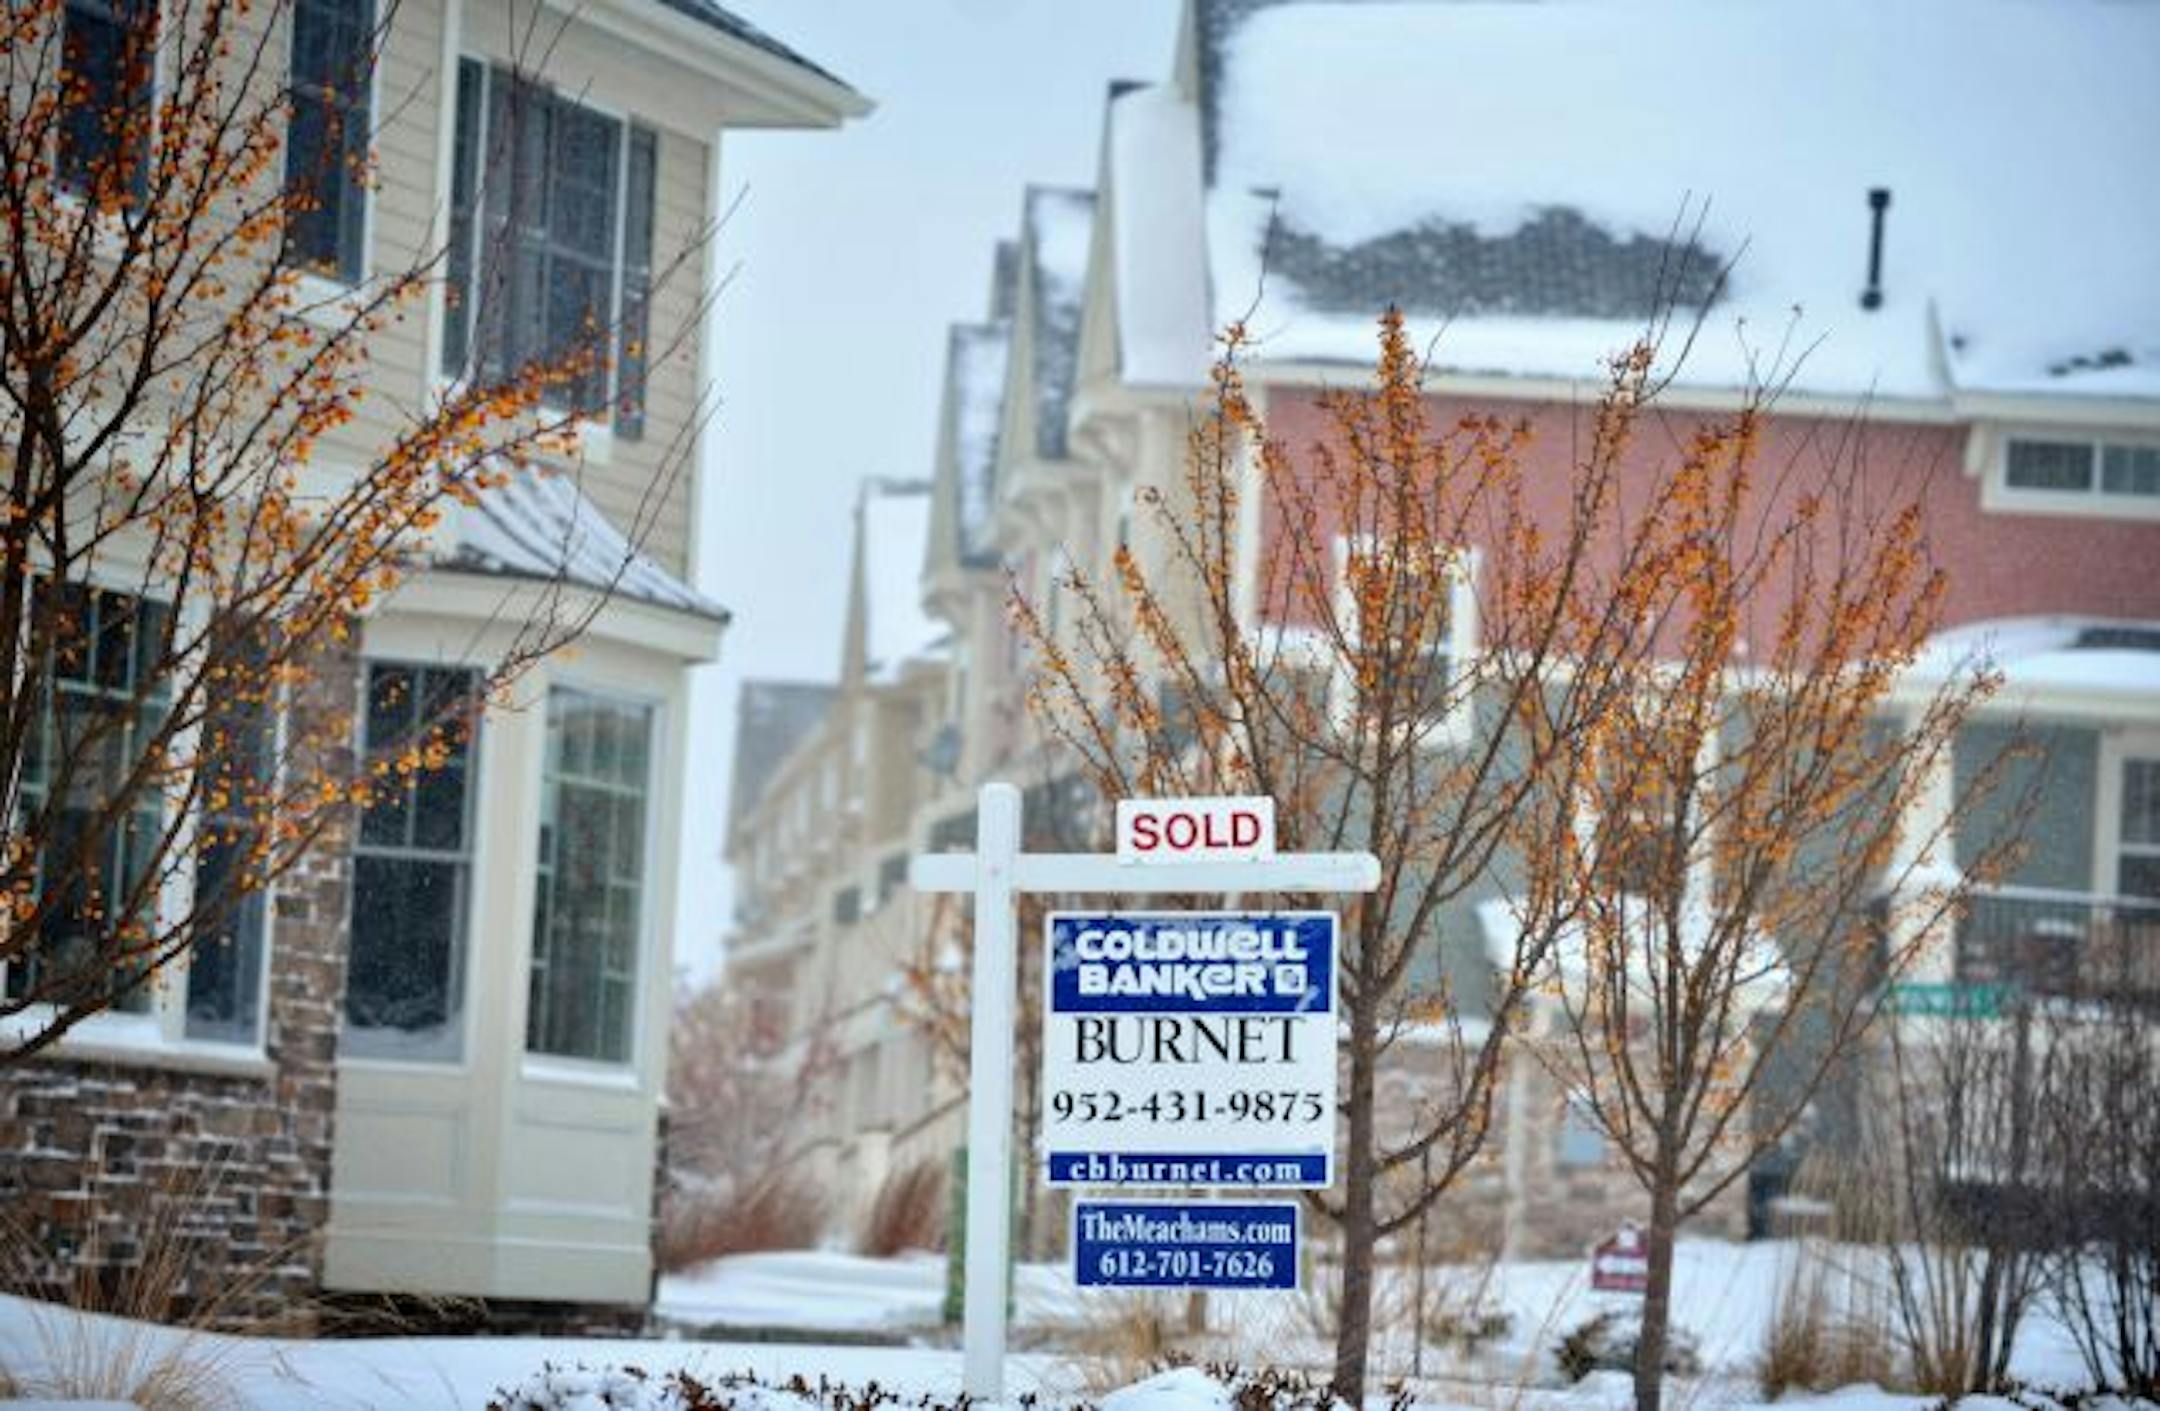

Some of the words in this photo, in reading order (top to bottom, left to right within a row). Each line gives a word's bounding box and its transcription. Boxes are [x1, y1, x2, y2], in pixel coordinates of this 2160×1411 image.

[1131, 812, 1262, 850] SOLD
[1074, 1016, 1305, 1064] BURNET
[1052, 1090, 1324, 1122] 952-431-9875
[1069, 1153, 1302, 1182] cbburnet.com
[1080, 1210, 1293, 1245] TheMeachams.com
[1099, 1250, 1275, 1279] 612-701-7626
